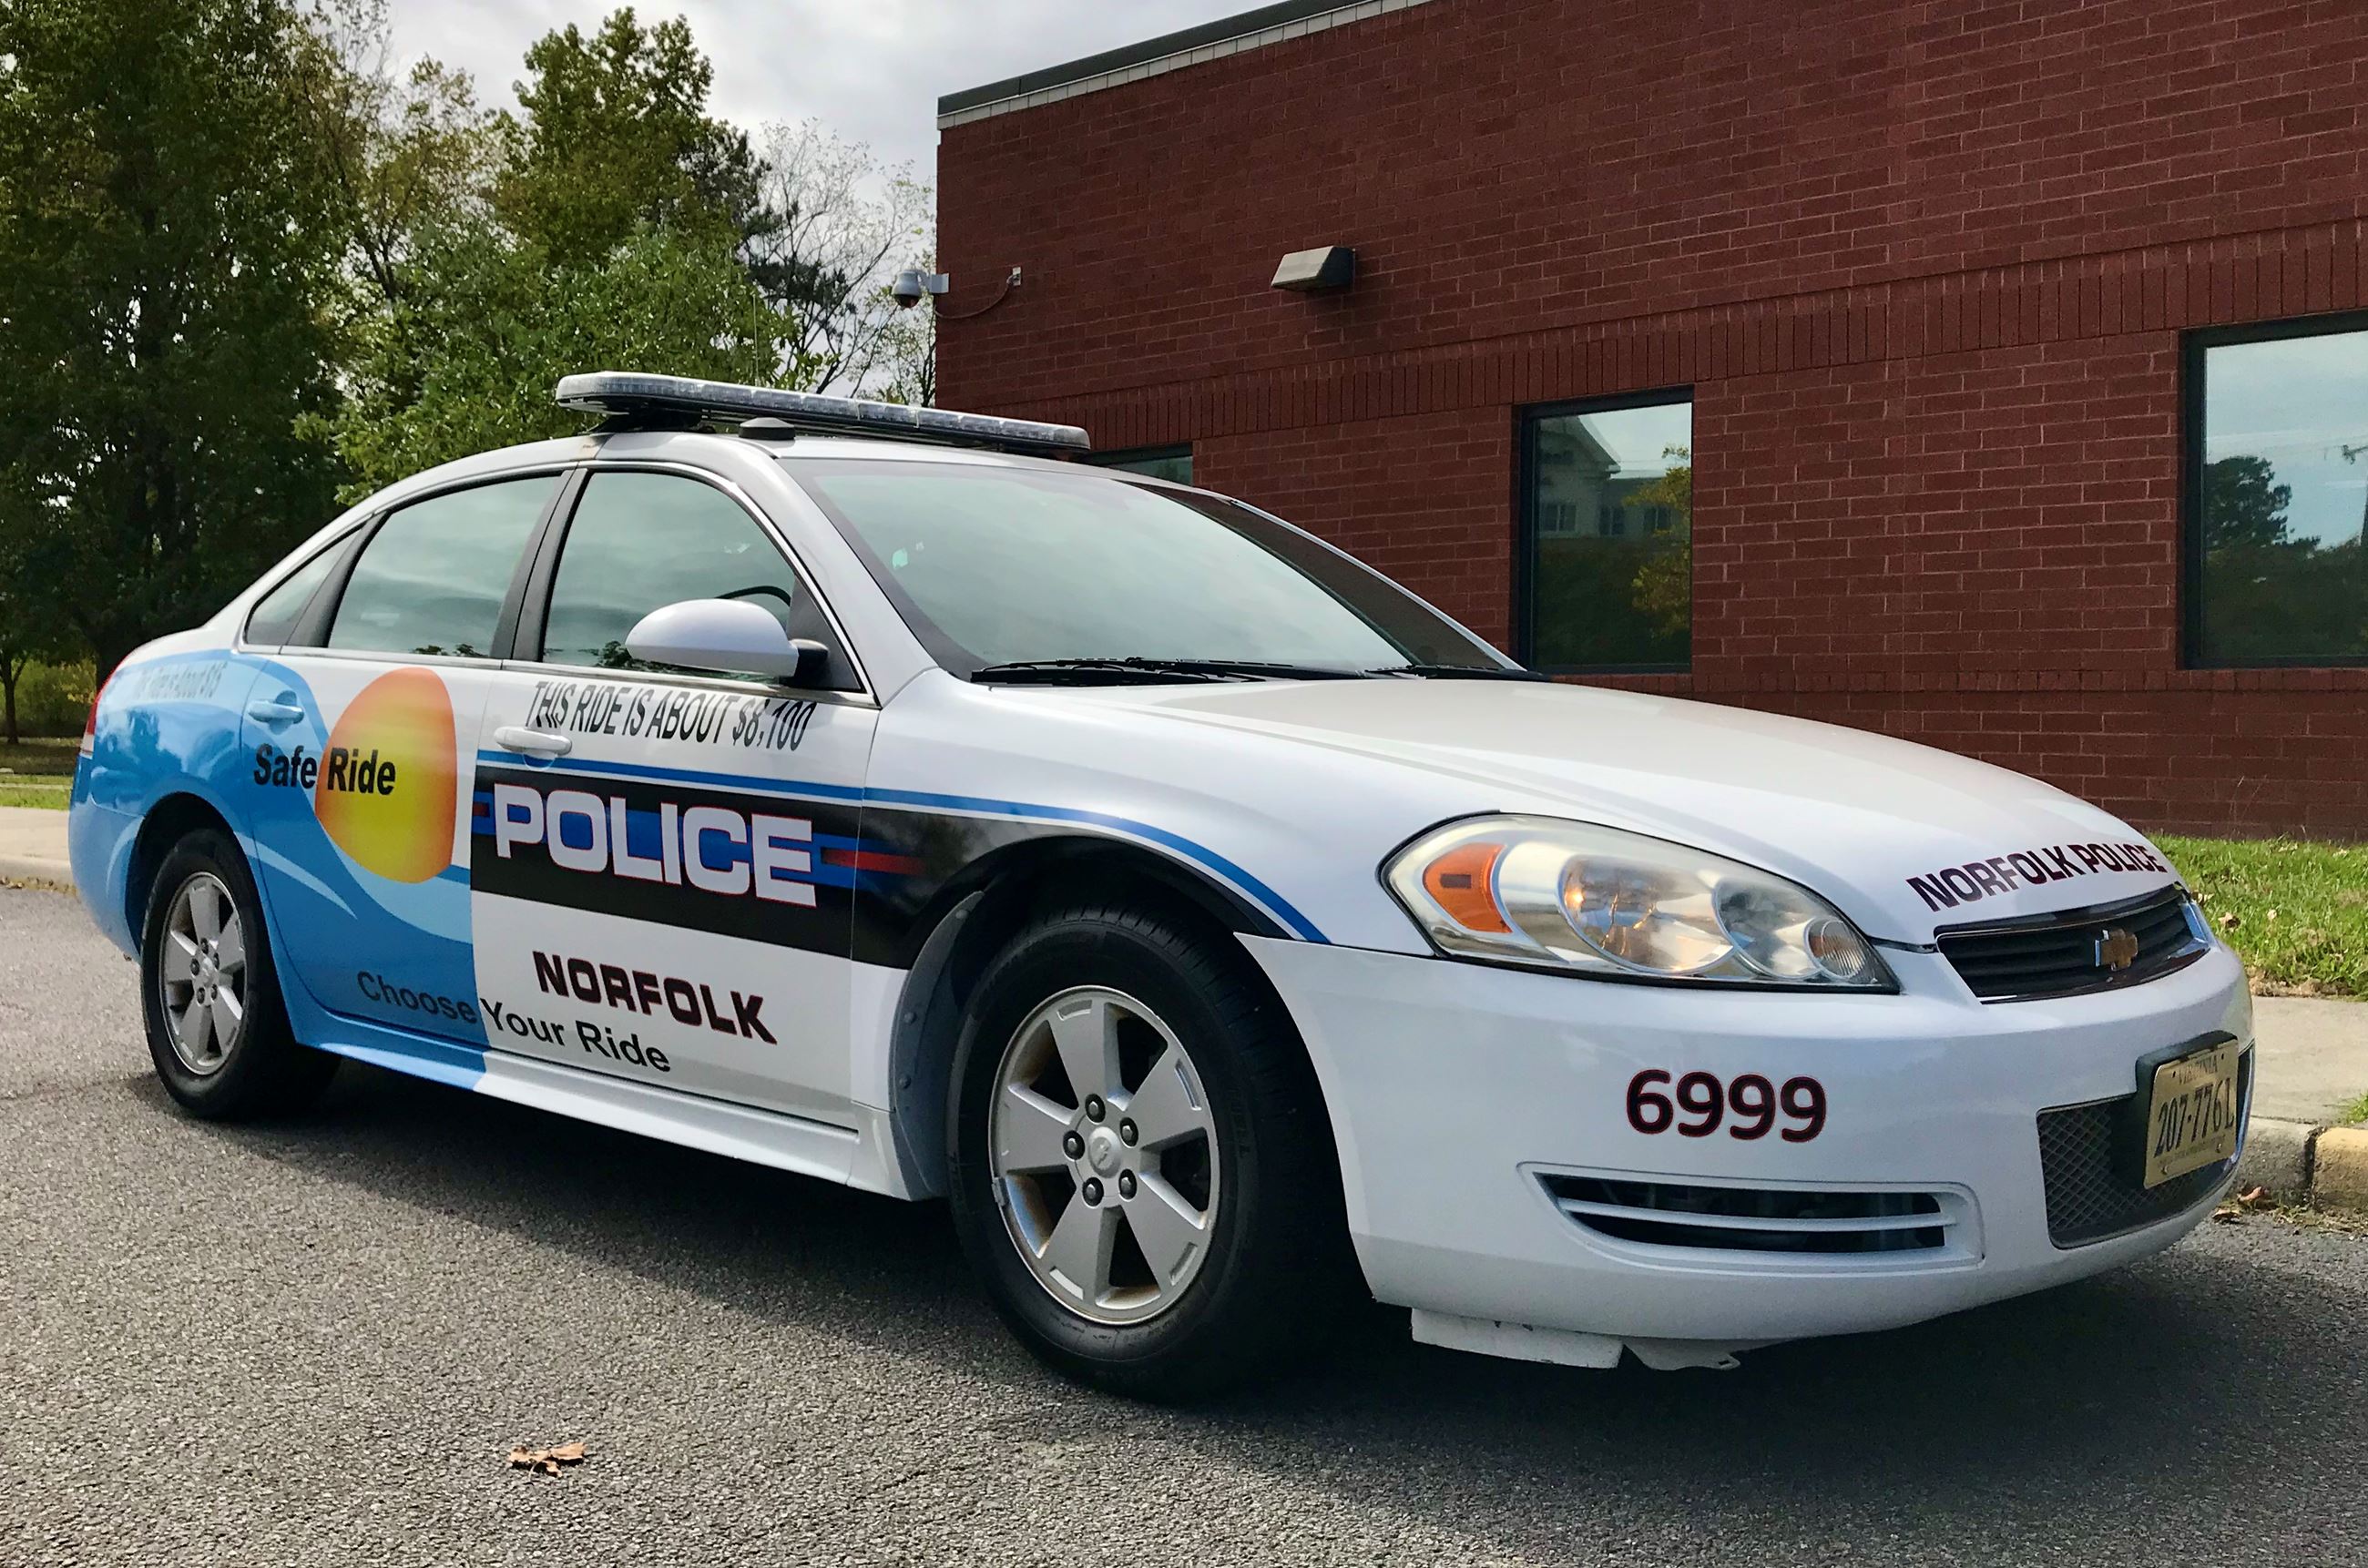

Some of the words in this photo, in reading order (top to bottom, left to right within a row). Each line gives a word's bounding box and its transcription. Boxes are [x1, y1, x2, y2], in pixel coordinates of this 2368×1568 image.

[526, 680, 575, 728] THIS
[569, 683, 632, 735] RIDE
[621, 688, 653, 736] IS
[645, 690, 739, 744] ABOUT
[732, 696, 818, 751] $8,100
[254, 743, 317, 789] Safe
[327, 747, 396, 795] Ride
[494, 782, 817, 908] POLICE
[1905, 845, 2087, 912] NORFOLK
[2067, 843, 2169, 874] POLICE
[357, 971, 479, 1024] Choose
[479, 997, 566, 1046] Your
[575, 1019, 671, 1073] Ride
[532, 951, 777, 1045] NORFOLK
[1627, 1069, 1827, 1143] 6999
